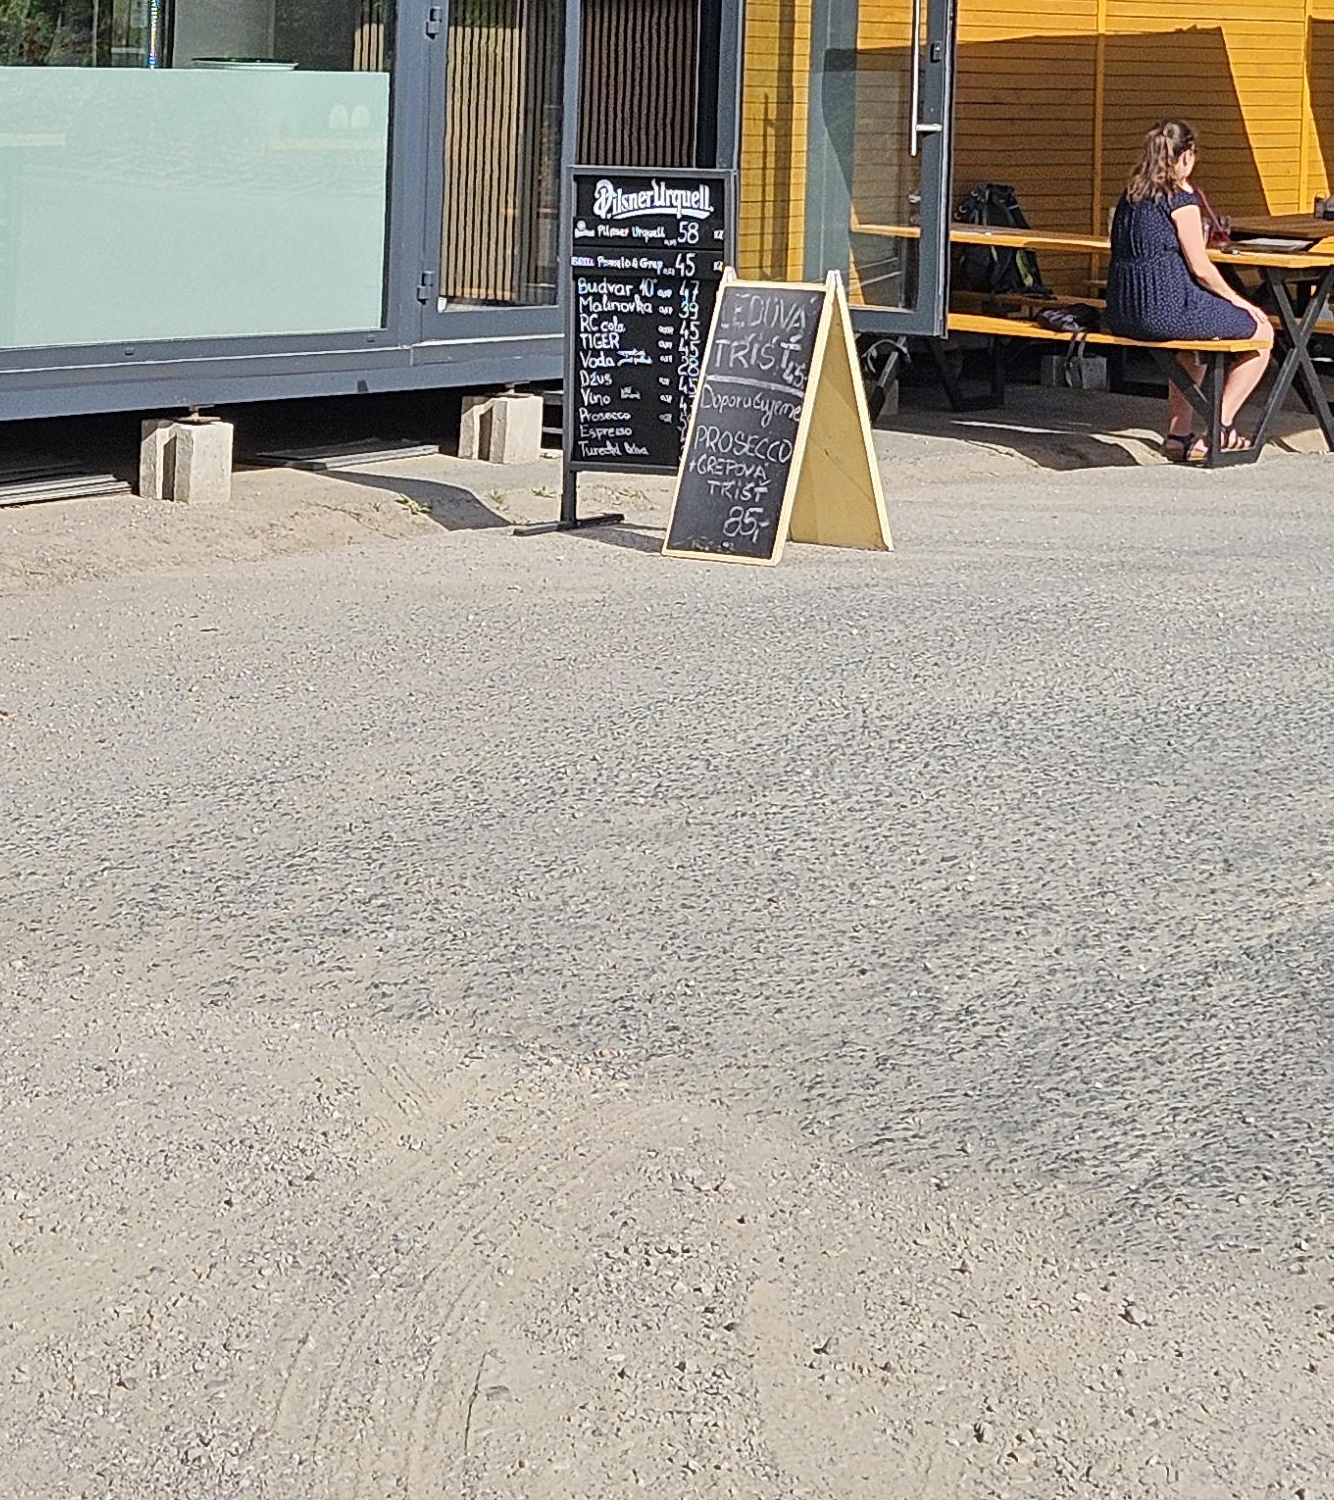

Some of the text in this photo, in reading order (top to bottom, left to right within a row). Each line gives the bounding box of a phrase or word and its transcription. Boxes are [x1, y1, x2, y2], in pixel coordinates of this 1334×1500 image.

[593, 178, 714, 219] Pilsner Urquell
[677, 221, 700, 244] 58
[675, 253, 696, 277] 45
[578, 277, 634, 296] Budvar
[679, 280, 700, 303] 47
[579, 294, 653, 314] Malinovka
[678, 301, 700, 320] 39
[579, 313, 599, 333] RC
[600, 315, 627, 333] cola
[679, 320, 701, 340] 45
[579, 332, 620, 350] TIGER
[678, 338, 701, 358] 45
[579, 350, 616, 368] Voda
[677, 357, 700, 376] 28
[578, 407, 632, 423] Prosecco
[694, 425, 793, 463] PROSECCO
